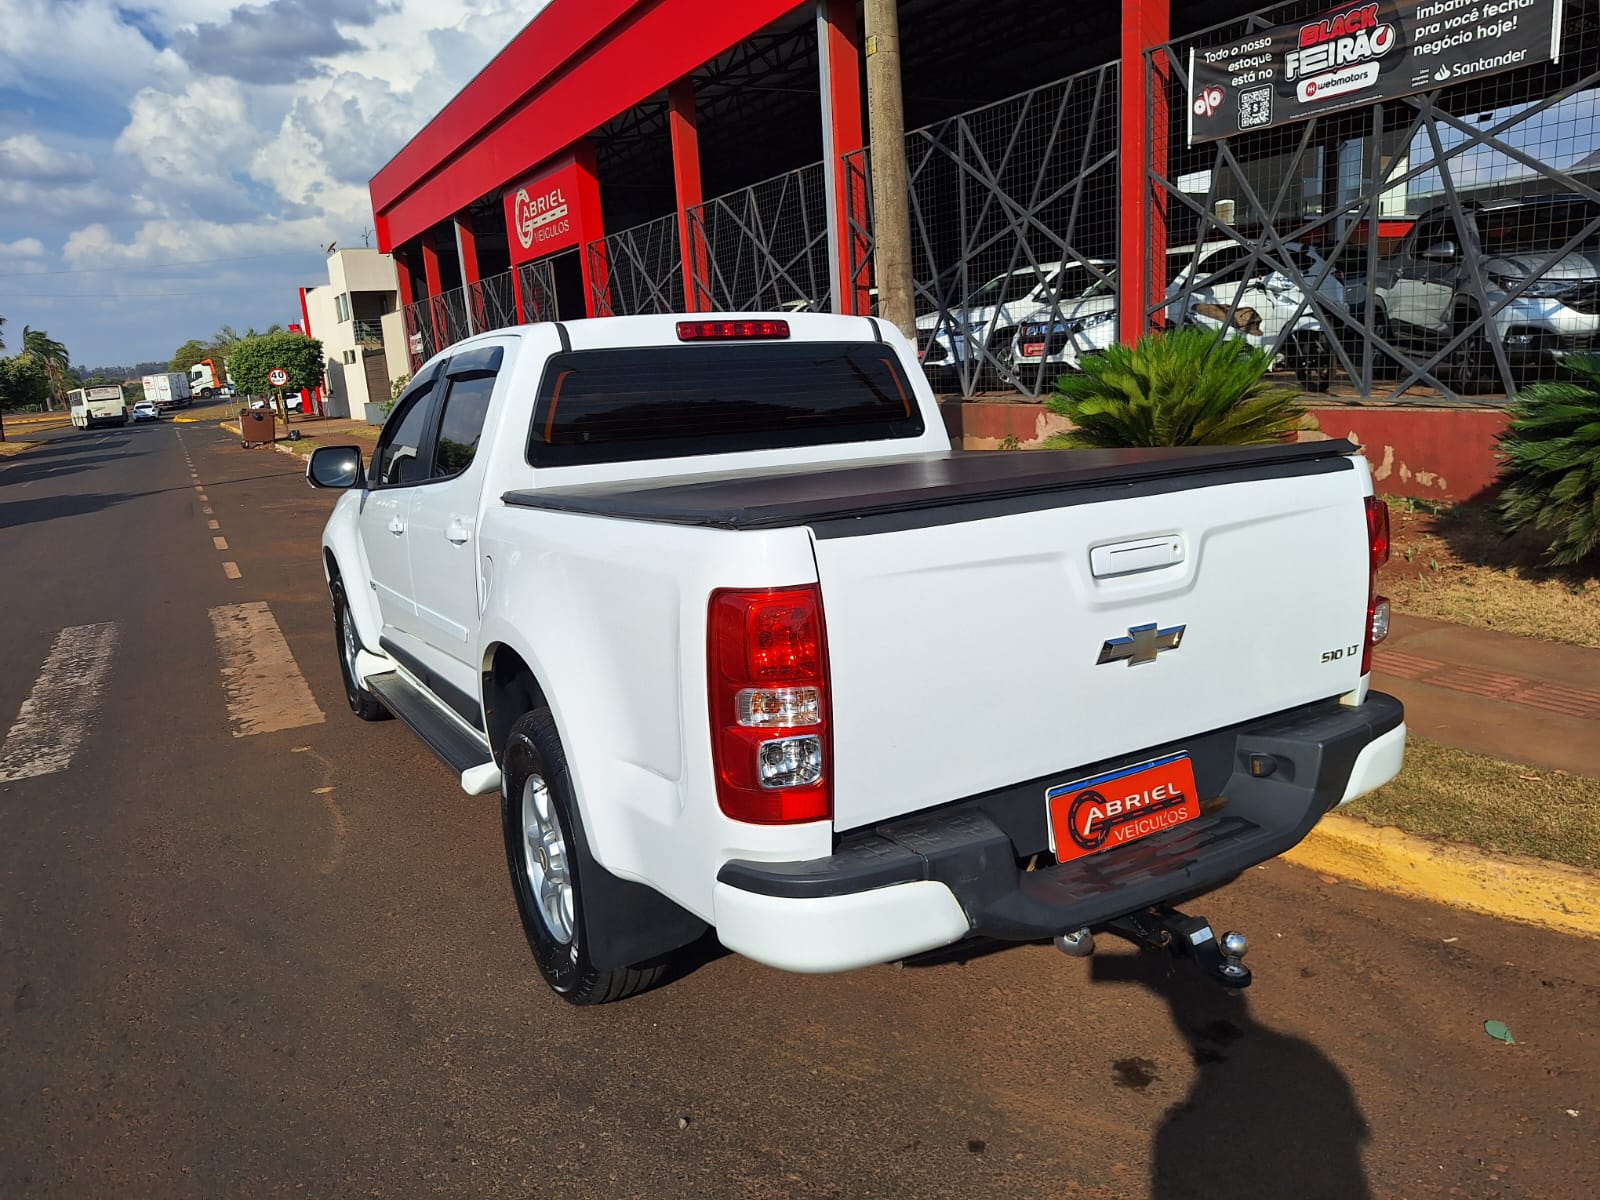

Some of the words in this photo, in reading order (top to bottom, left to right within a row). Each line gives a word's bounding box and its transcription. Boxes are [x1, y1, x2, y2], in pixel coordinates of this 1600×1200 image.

[1300, 4, 1378, 47] BLACK
[1413, 30, 1473, 57] negócio
[1477, 15, 1518, 39] hoje!
[1414, 22, 1441, 41] pra
[1444, 8, 1479, 30] você
[1204, 48, 1229, 63] Todo
[1230, 47, 1239, 56] o
[1240, 37, 1272, 53] nosso
[1228, 53, 1273, 72] estoque
[1286, 26, 1394, 78] FEIRÃO
[1452, 49, 1528, 77] Santander
[1231, 70, 1256, 86] está
[1258, 68, 1273, 80] no
[1317, 71, 1369, 90] webmotors
[271, 371, 284, 379] 40
[1347, 644, 1360, 657] LT
